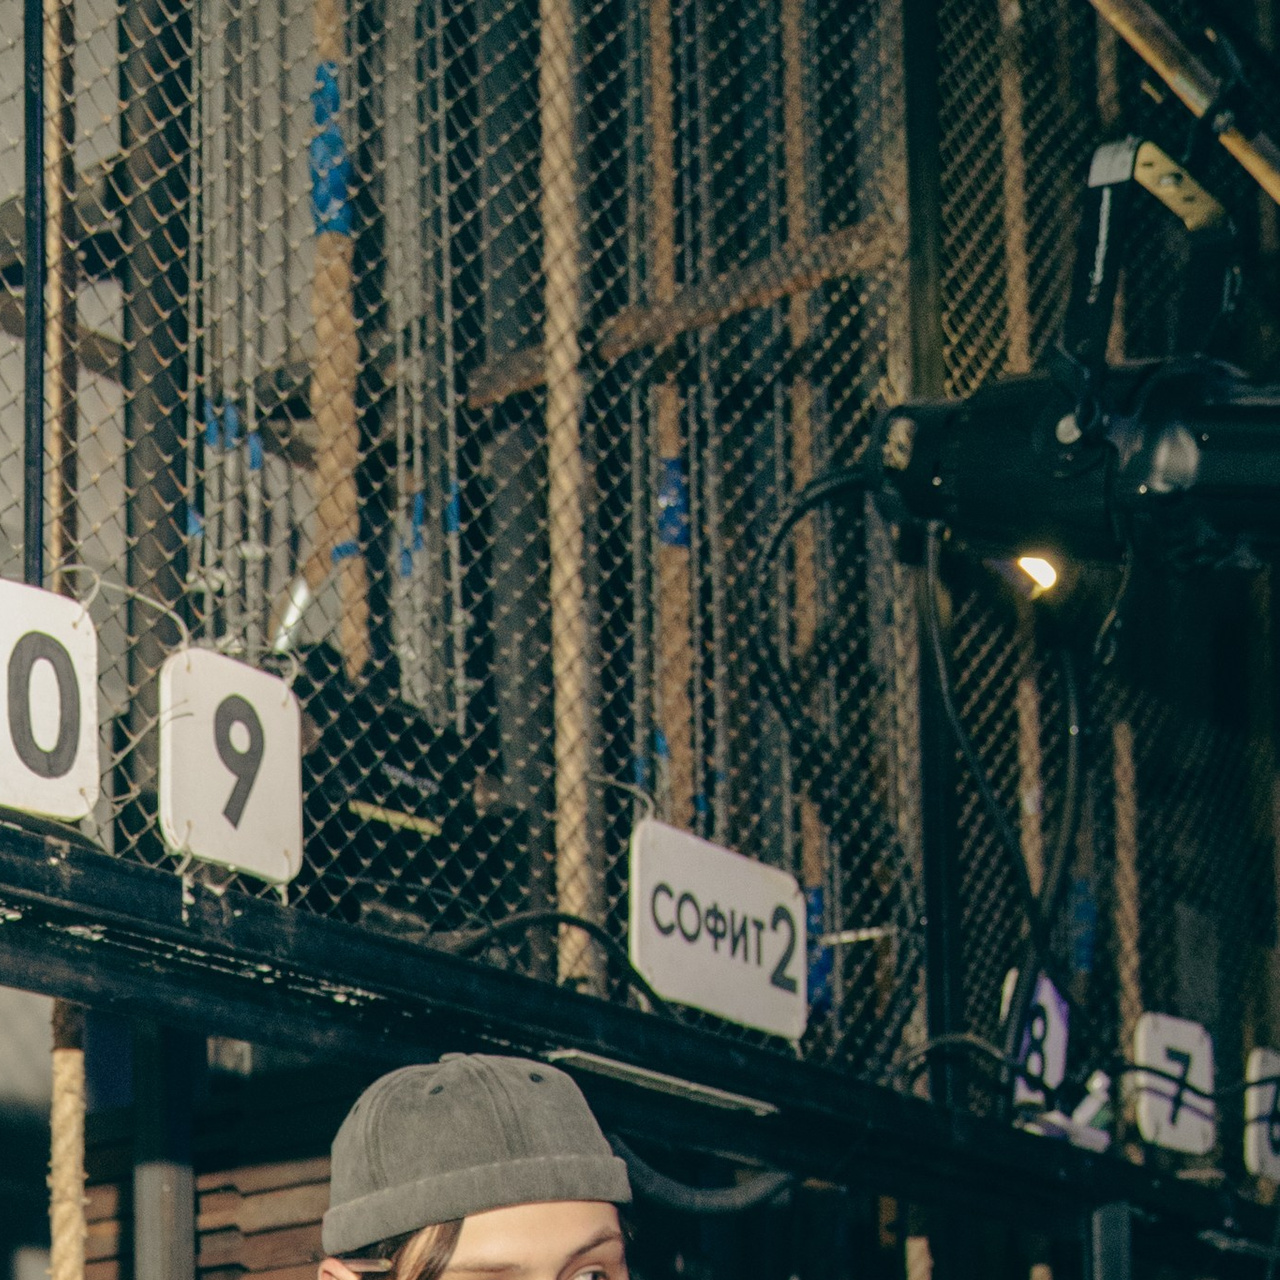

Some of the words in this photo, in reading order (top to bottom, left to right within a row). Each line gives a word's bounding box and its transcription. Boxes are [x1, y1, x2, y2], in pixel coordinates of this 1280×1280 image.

[213, 693, 265, 830] 9
[651, 882, 765, 967] СОФИТ
[770, 904, 799, 996] 2
[1165, 1046, 1191, 1126] 7
